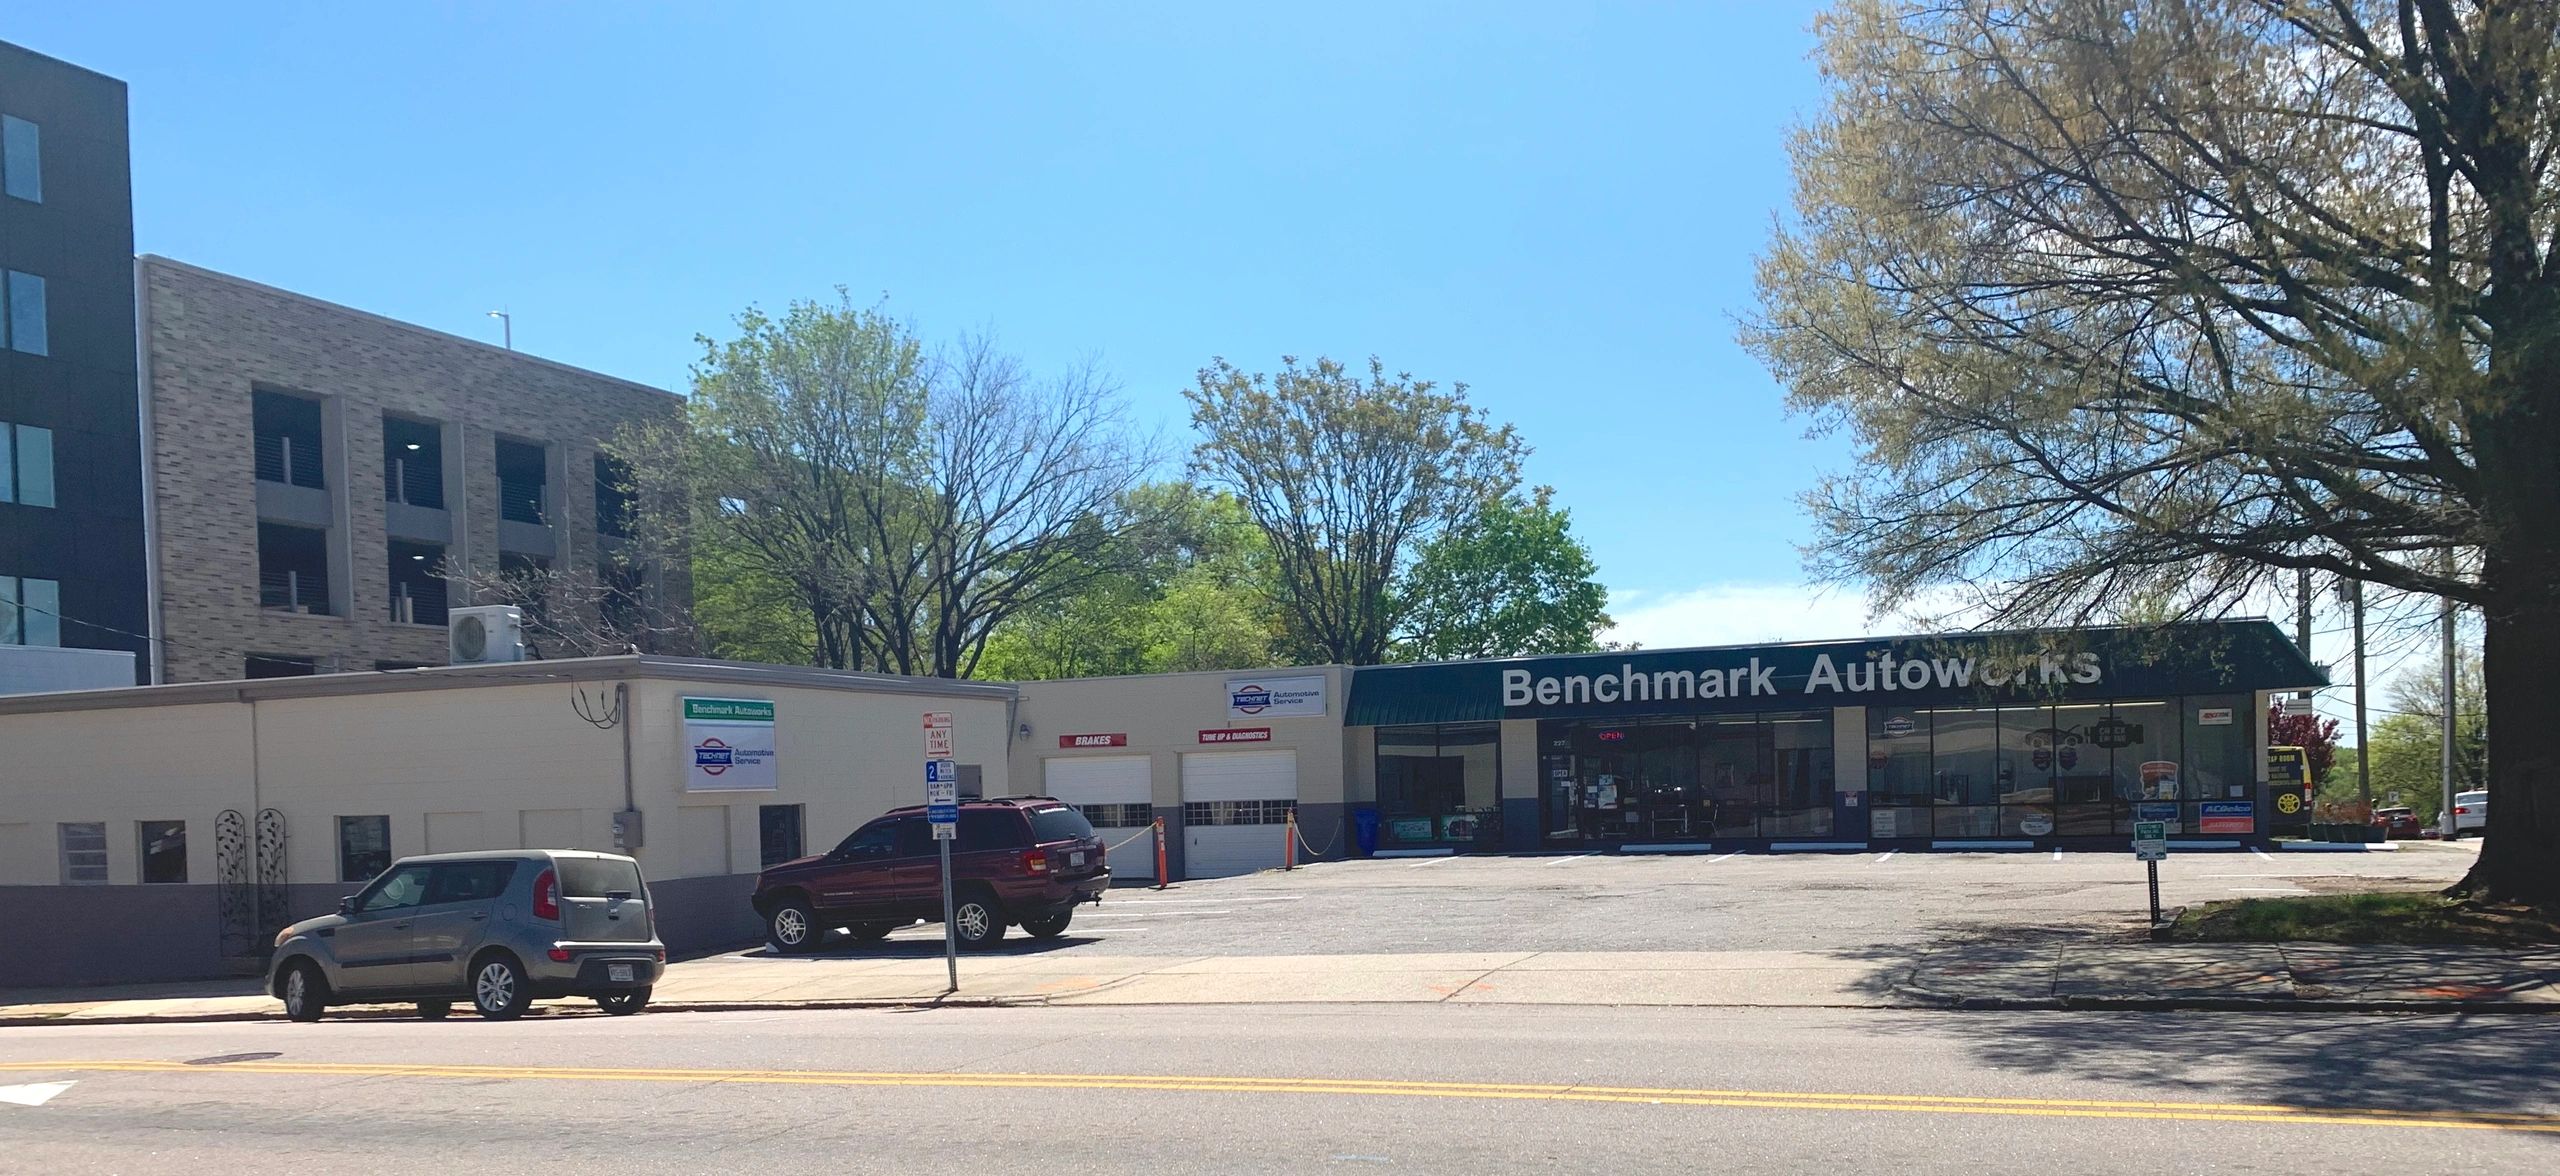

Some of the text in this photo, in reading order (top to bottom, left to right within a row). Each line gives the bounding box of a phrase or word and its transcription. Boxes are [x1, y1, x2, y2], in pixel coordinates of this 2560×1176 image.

[1501, 651, 2102, 706] Benchmark Autoworks
[1273, 690, 1319, 698] Automotive
[692, 704, 772, 716] Benchmark Autoworks
[930, 730, 947, 739] ANY
[1202, 733, 1217, 741] TUNE
[1232, 731, 1268, 740] DIAGNOSTICS
[1600, 731, 1624, 740] OPEN
[930, 740, 949, 749] TIME
[1075, 735, 1112, 746] BRAKES
[734, 749, 774, 757] Automotive
[734, 757, 760, 765] Service
[928, 765, 935, 779] 2
[2204, 805, 2252, 813] ACDelco
